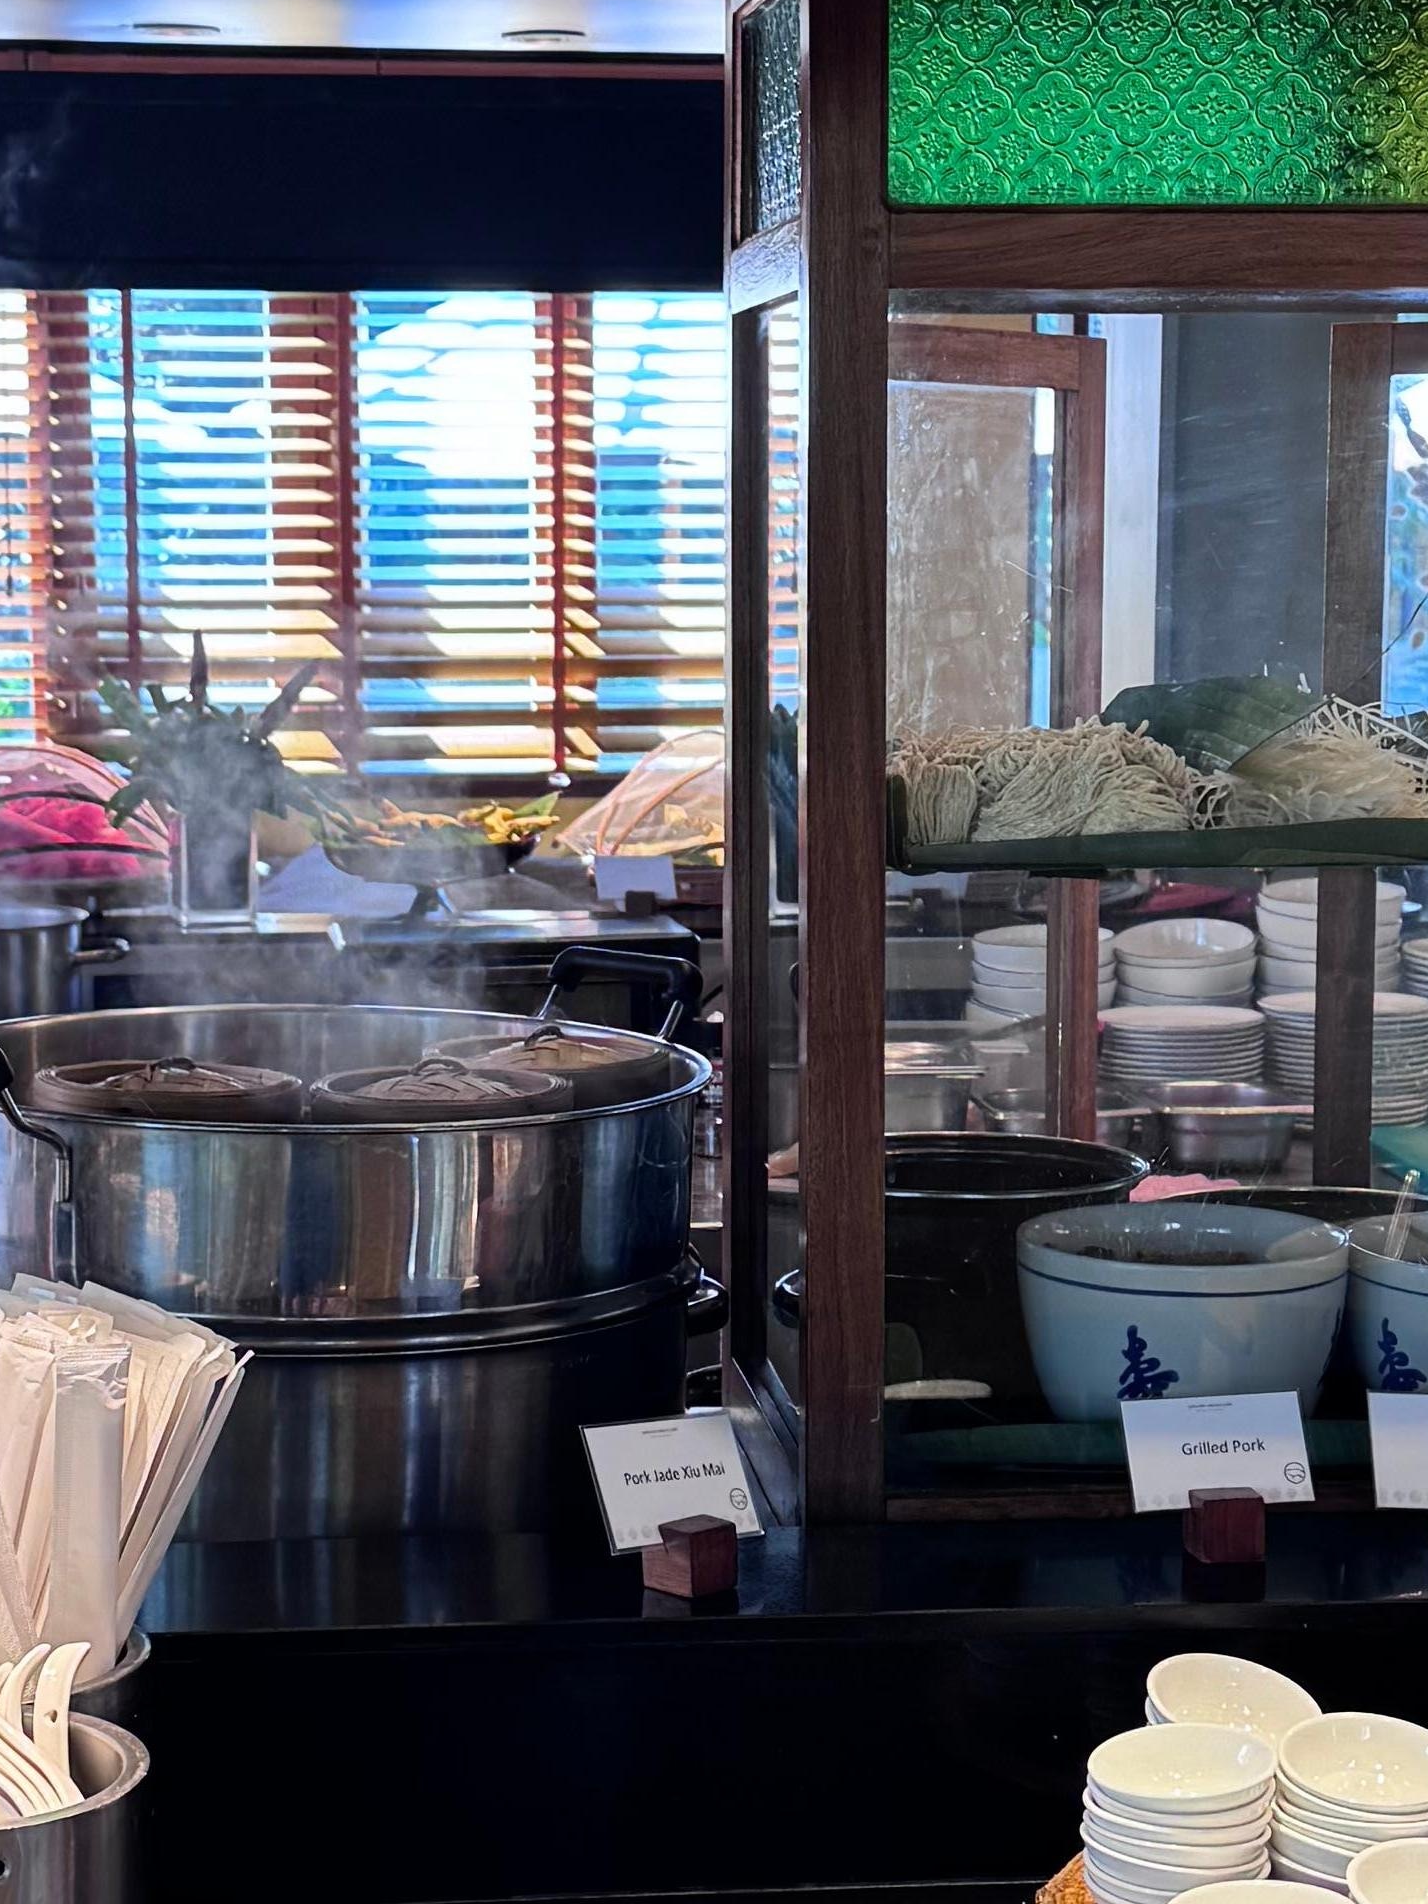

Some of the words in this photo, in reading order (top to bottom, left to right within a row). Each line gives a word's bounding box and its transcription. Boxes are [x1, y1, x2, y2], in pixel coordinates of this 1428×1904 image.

[1181, 1440, 1228, 1456] Grilled
[1232, 1437, 1265, 1453] Pork
[624, 1471, 652, 1485] Pork
[654, 1467, 680, 1482] Jade
[681, 1465, 701, 1479] Xiu
[702, 1462, 725, 1476] Mai
